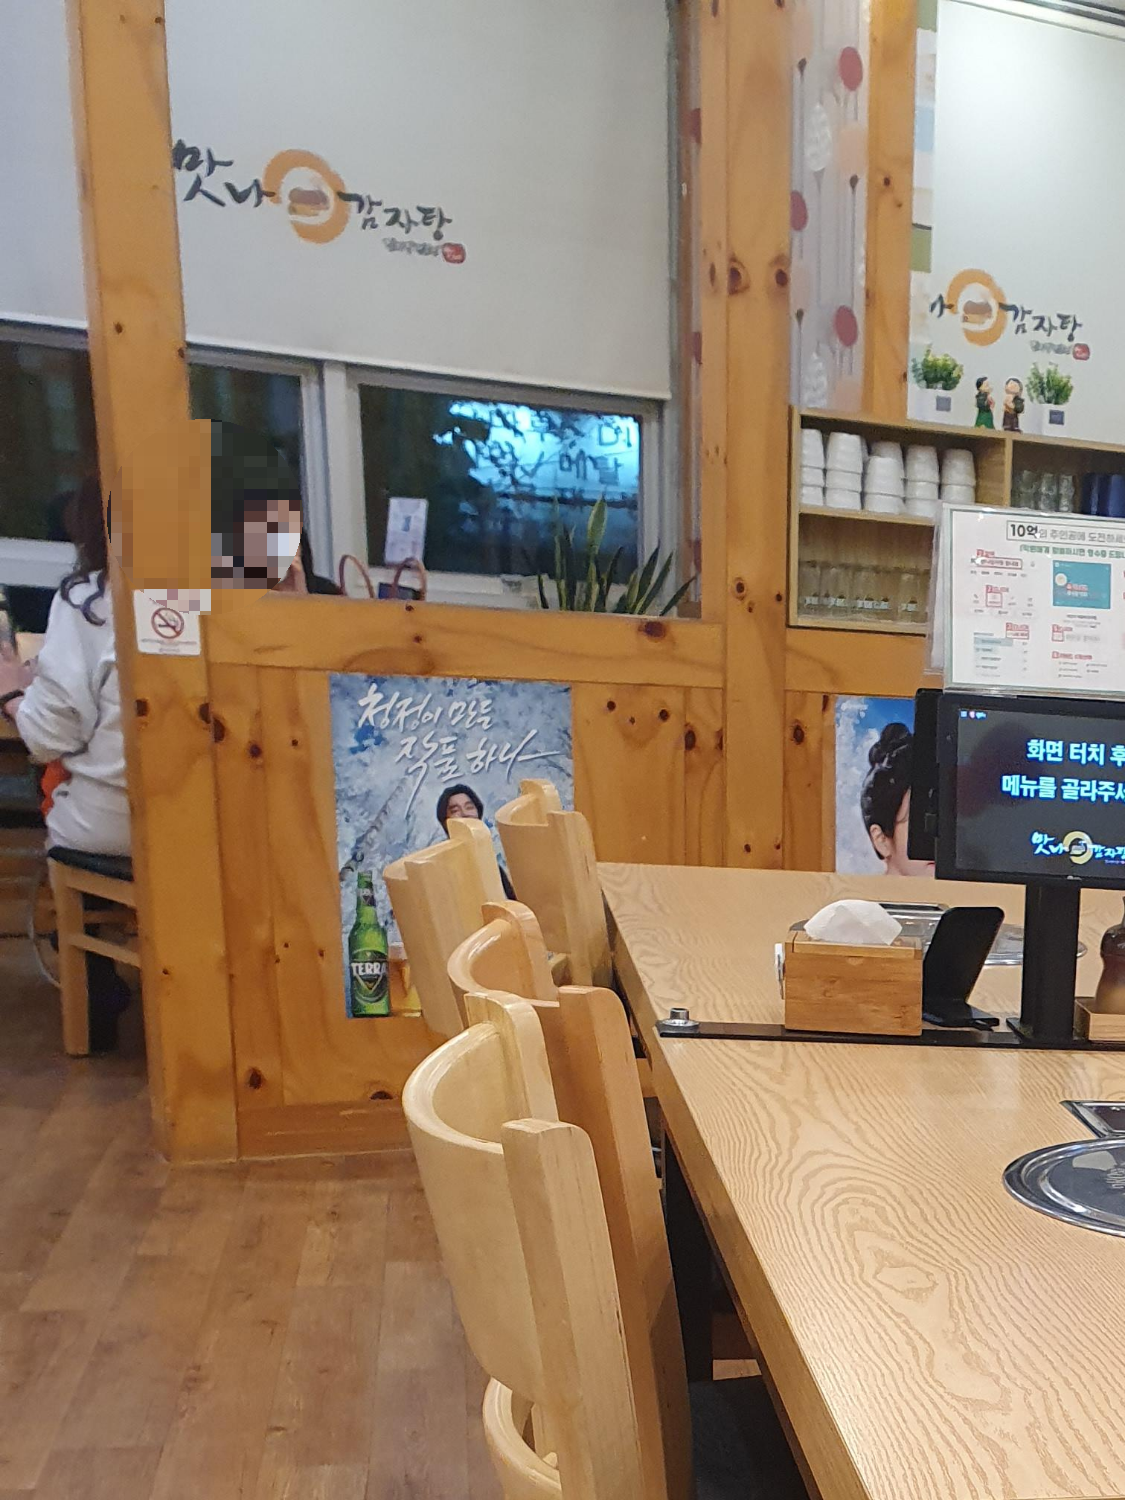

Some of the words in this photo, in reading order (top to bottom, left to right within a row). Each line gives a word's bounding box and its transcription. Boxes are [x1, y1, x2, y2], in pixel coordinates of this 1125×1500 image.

[337, 191, 453, 240] 감자탕
[999, 302, 1083, 342] 감자탕
[1027, 739, 1064, 762] 화면
[1069, 743, 1105, 766] 터치
[1001, 774, 1057, 799] 메뉴를
[350, 962, 388, 976] TERRA
